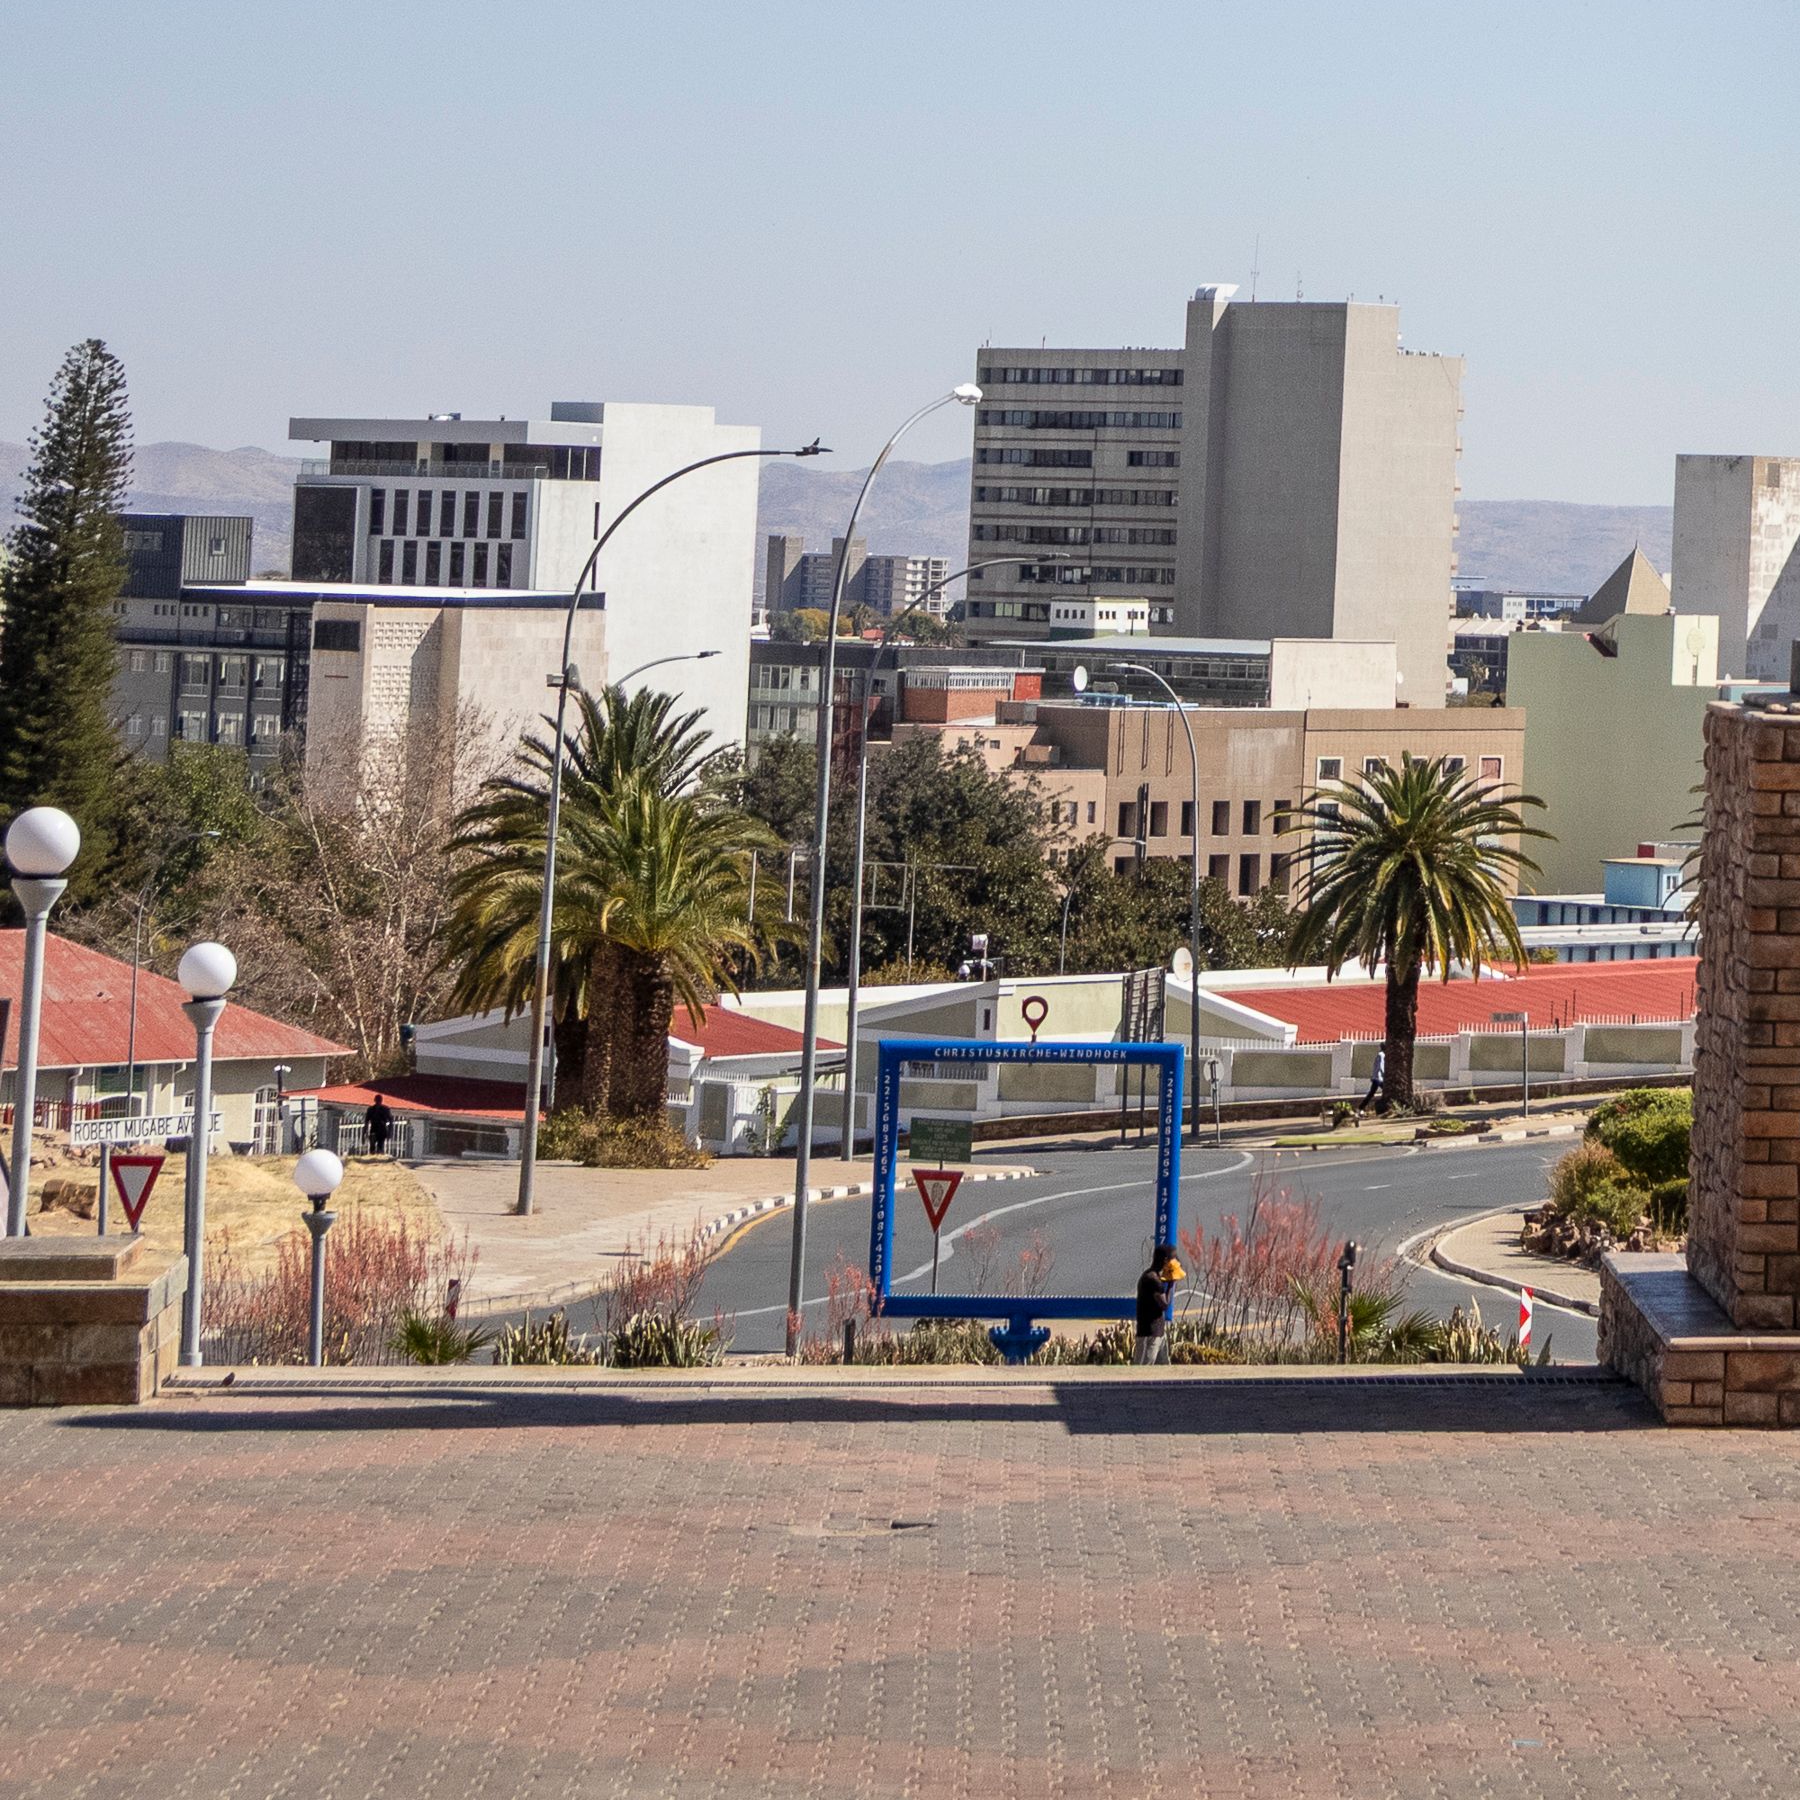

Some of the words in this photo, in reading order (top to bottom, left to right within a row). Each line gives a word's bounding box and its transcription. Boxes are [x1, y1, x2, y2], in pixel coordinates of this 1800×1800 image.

[934, 1047, 1127, 1059] CHRISTUSKIRCHE-WINDHOEK
[74, 1120, 121, 1142] ROBERT
[124, 1116, 173, 1139] MUGABE
[176, 1113, 221, 1134] AVEUE
